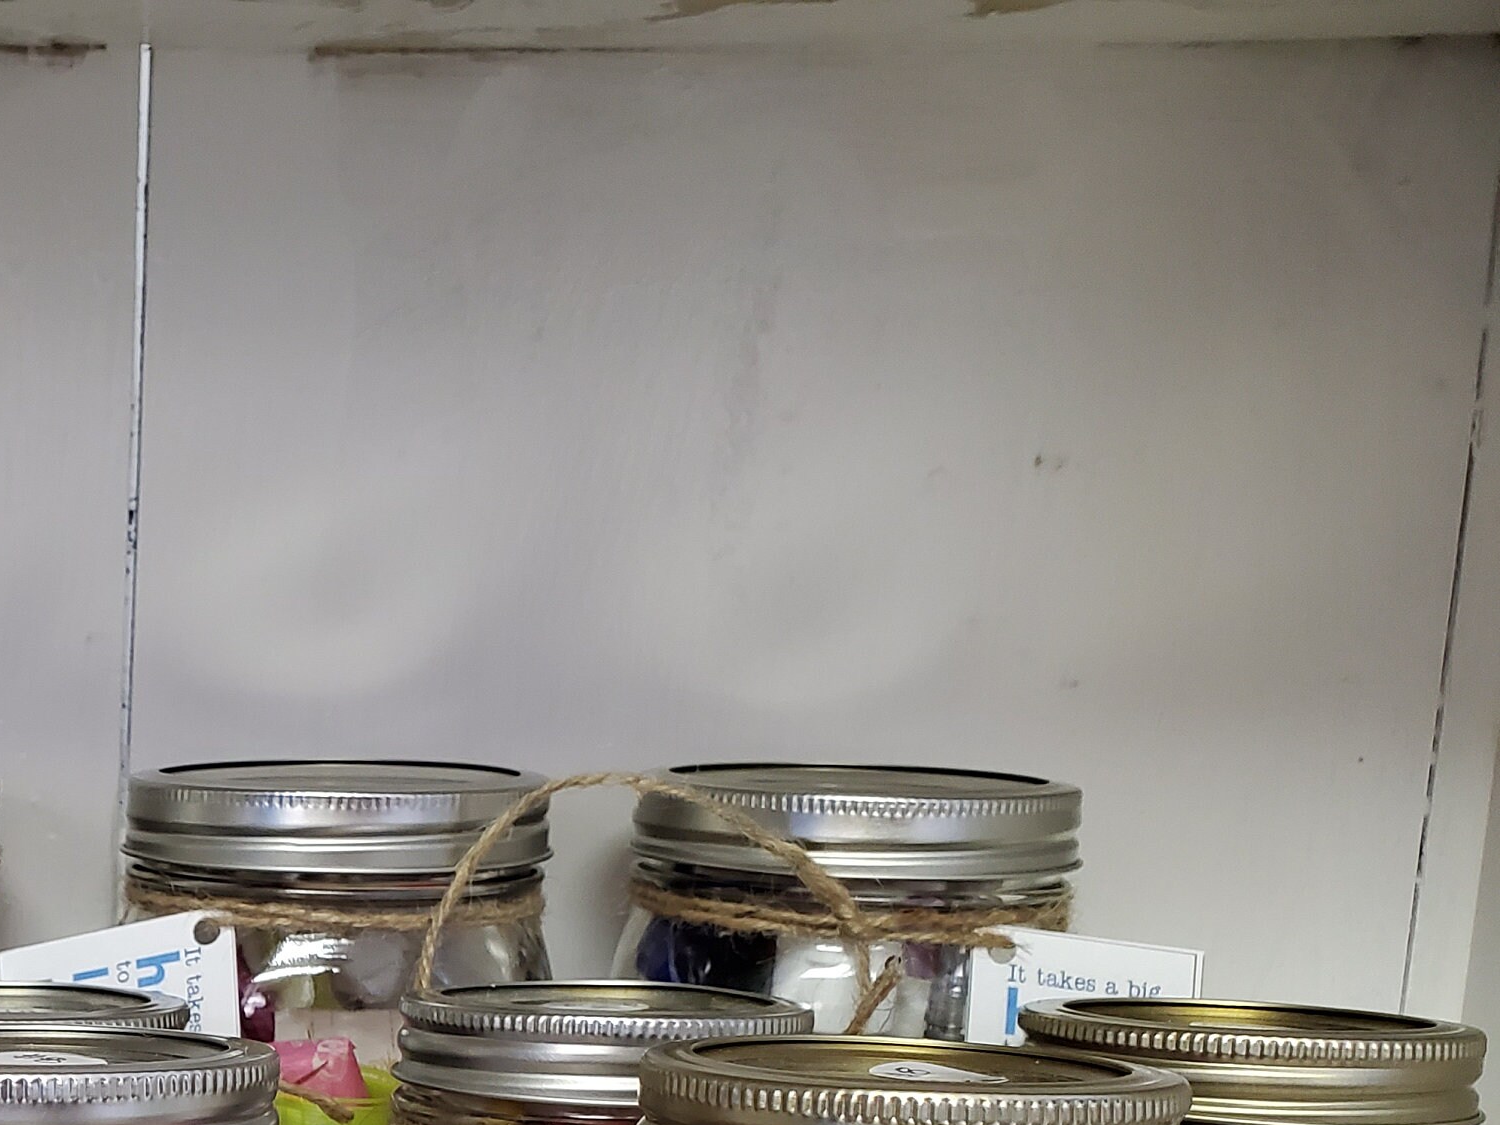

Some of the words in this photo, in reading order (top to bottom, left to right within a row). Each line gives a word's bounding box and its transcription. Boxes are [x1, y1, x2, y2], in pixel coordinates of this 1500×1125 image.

[184, 947, 201, 967] It
[116, 960, 132, 983] to
[1007, 963, 1026, 983] It
[1037, 968, 1096, 993] takes
[1105, 980, 1118, 995] a
